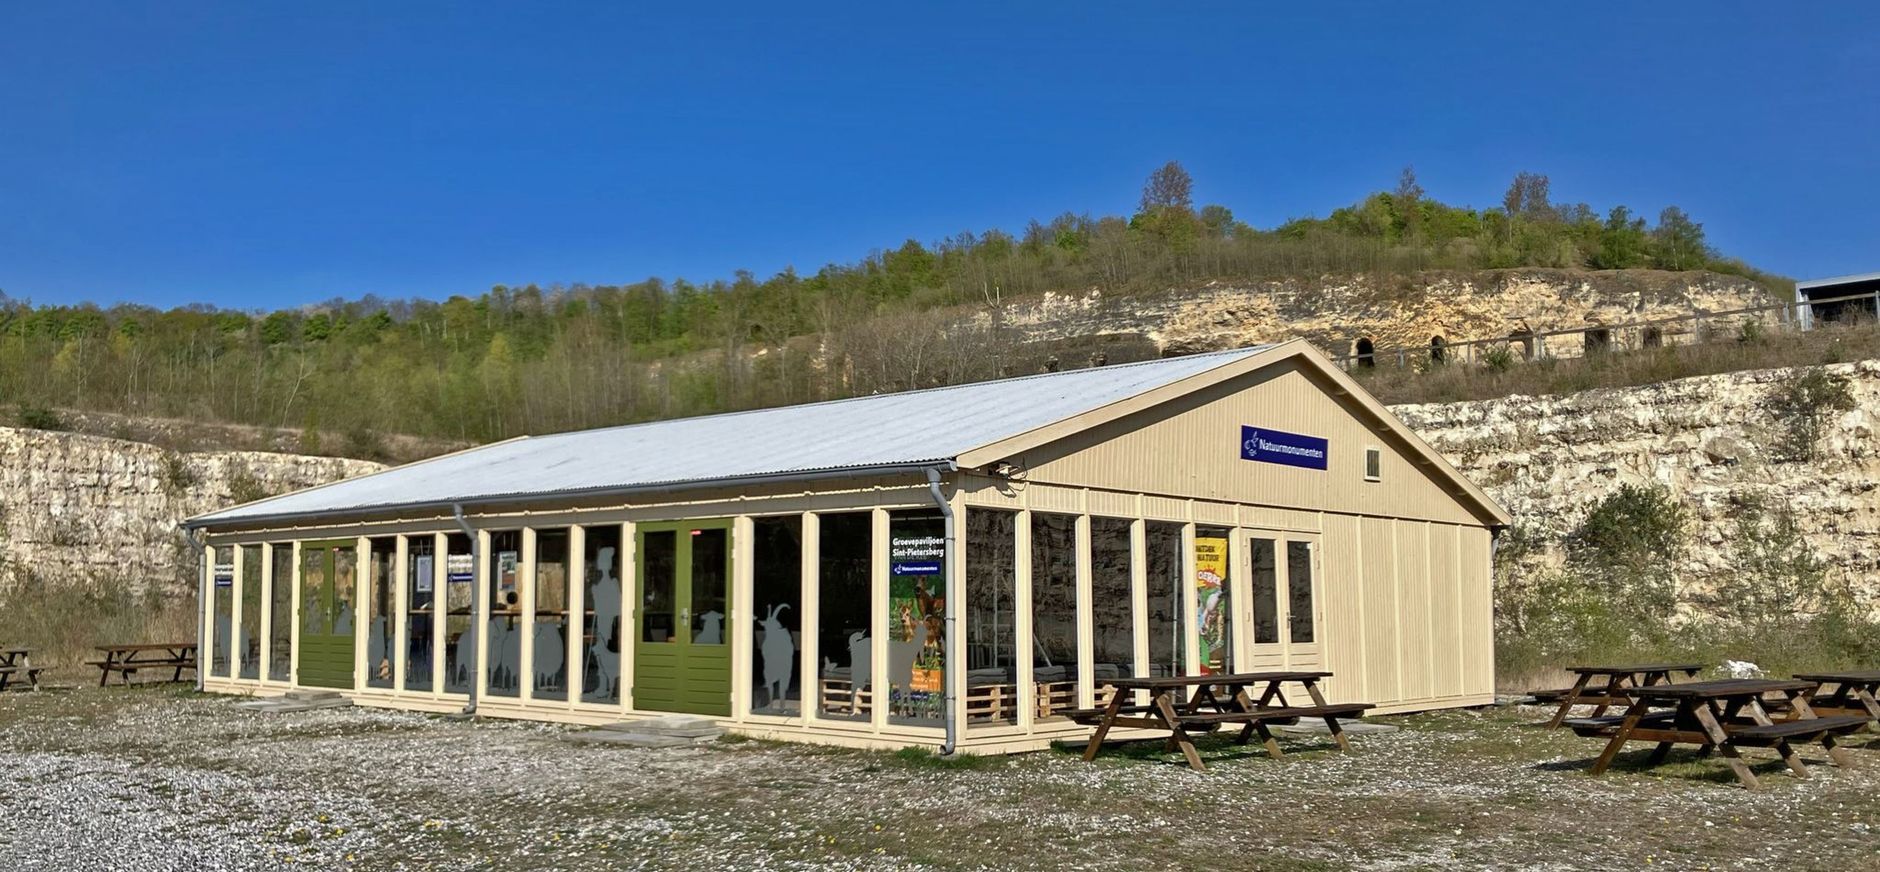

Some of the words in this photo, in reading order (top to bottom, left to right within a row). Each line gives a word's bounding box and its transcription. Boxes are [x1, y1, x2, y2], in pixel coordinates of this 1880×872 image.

[1259, 438, 1323, 459] Natuurmonumenten
[892, 536, 944, 547] Groevepaviljoen
[892, 547, 944, 557] Sint-Pietersberg
